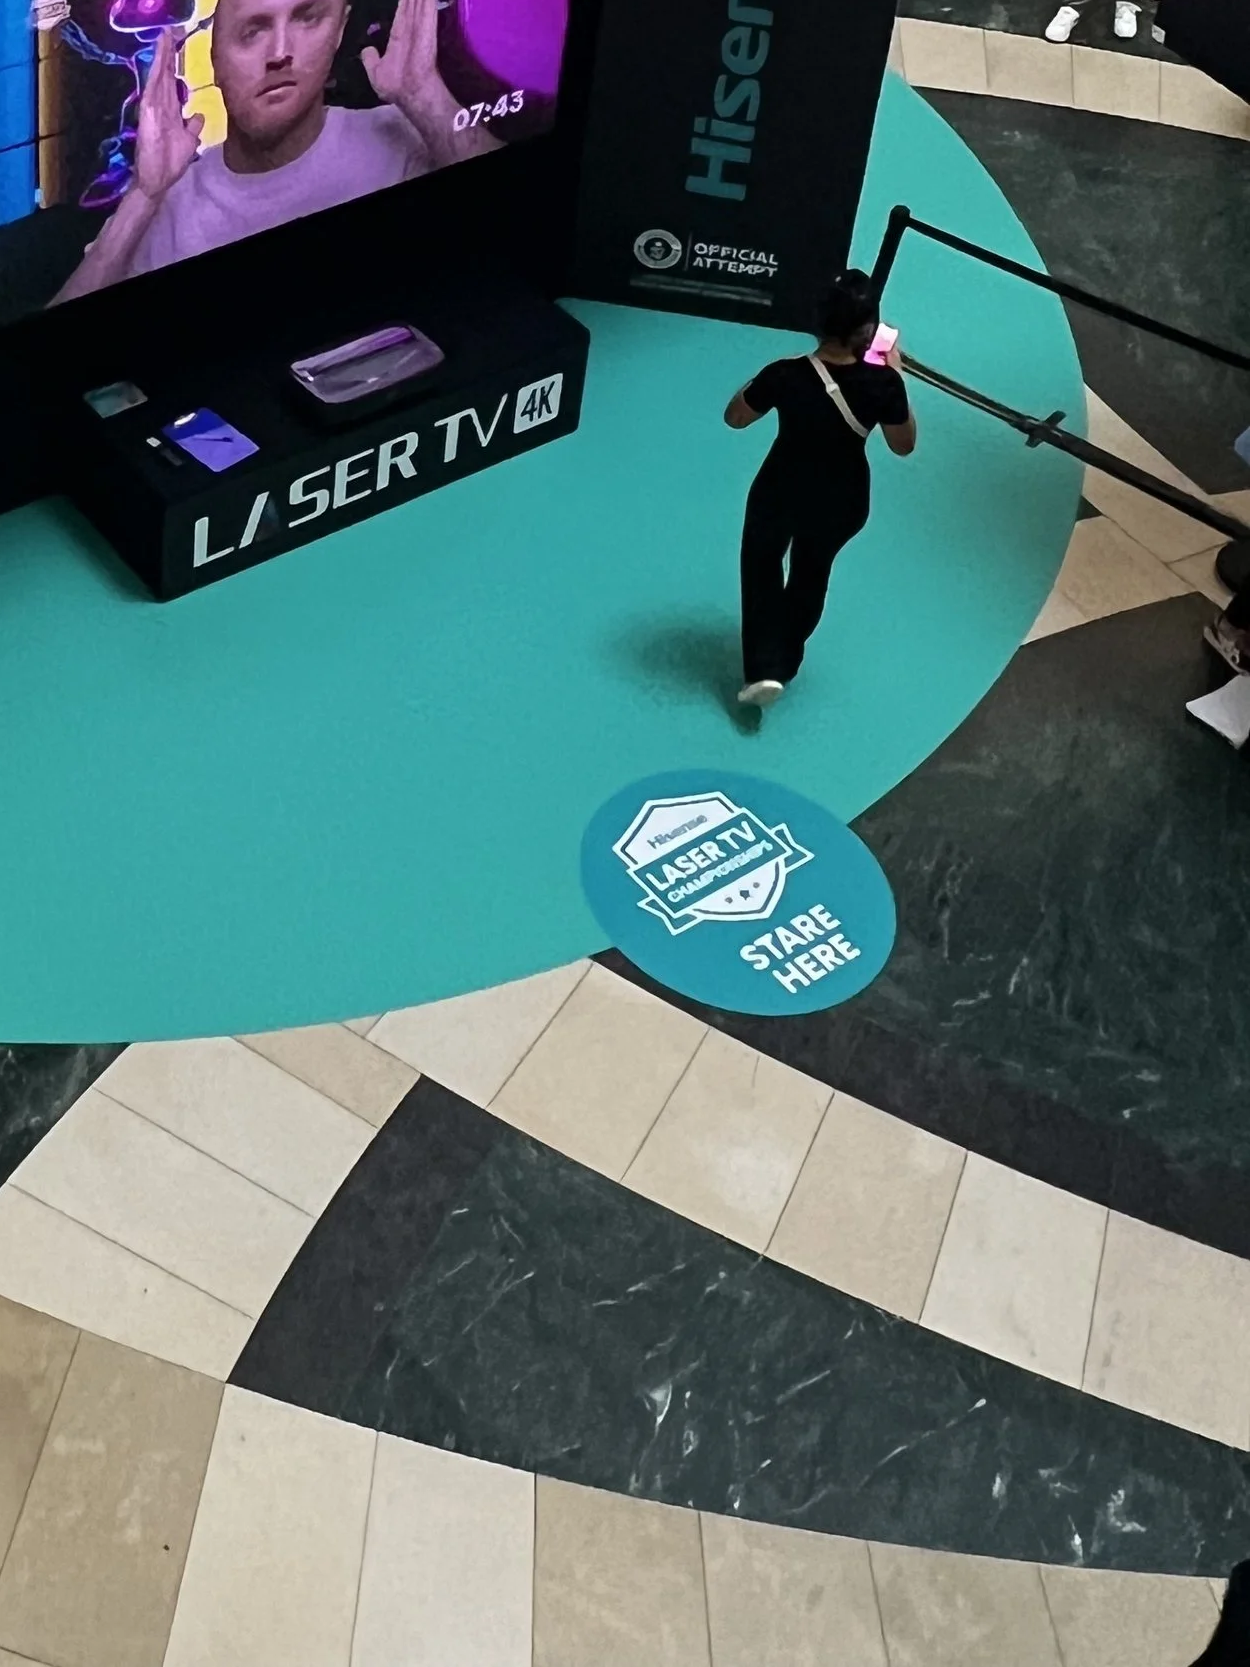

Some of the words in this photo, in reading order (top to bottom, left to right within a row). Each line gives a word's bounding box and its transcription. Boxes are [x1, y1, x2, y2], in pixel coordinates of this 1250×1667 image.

[453, 89, 524, 132] 07:43
[693, 256, 778, 278] ATTEMPT
[694, 242, 779, 266] OFFICIAL
[193, 432, 419, 568] LASER
[435, 393, 508, 463] TV
[519, 379, 555, 422] 4K
[646, 841, 727, 891] LASER
[715, 820, 756, 850] TV
[739, 903, 842, 971] STARE
[772, 933, 861, 994] HERE
